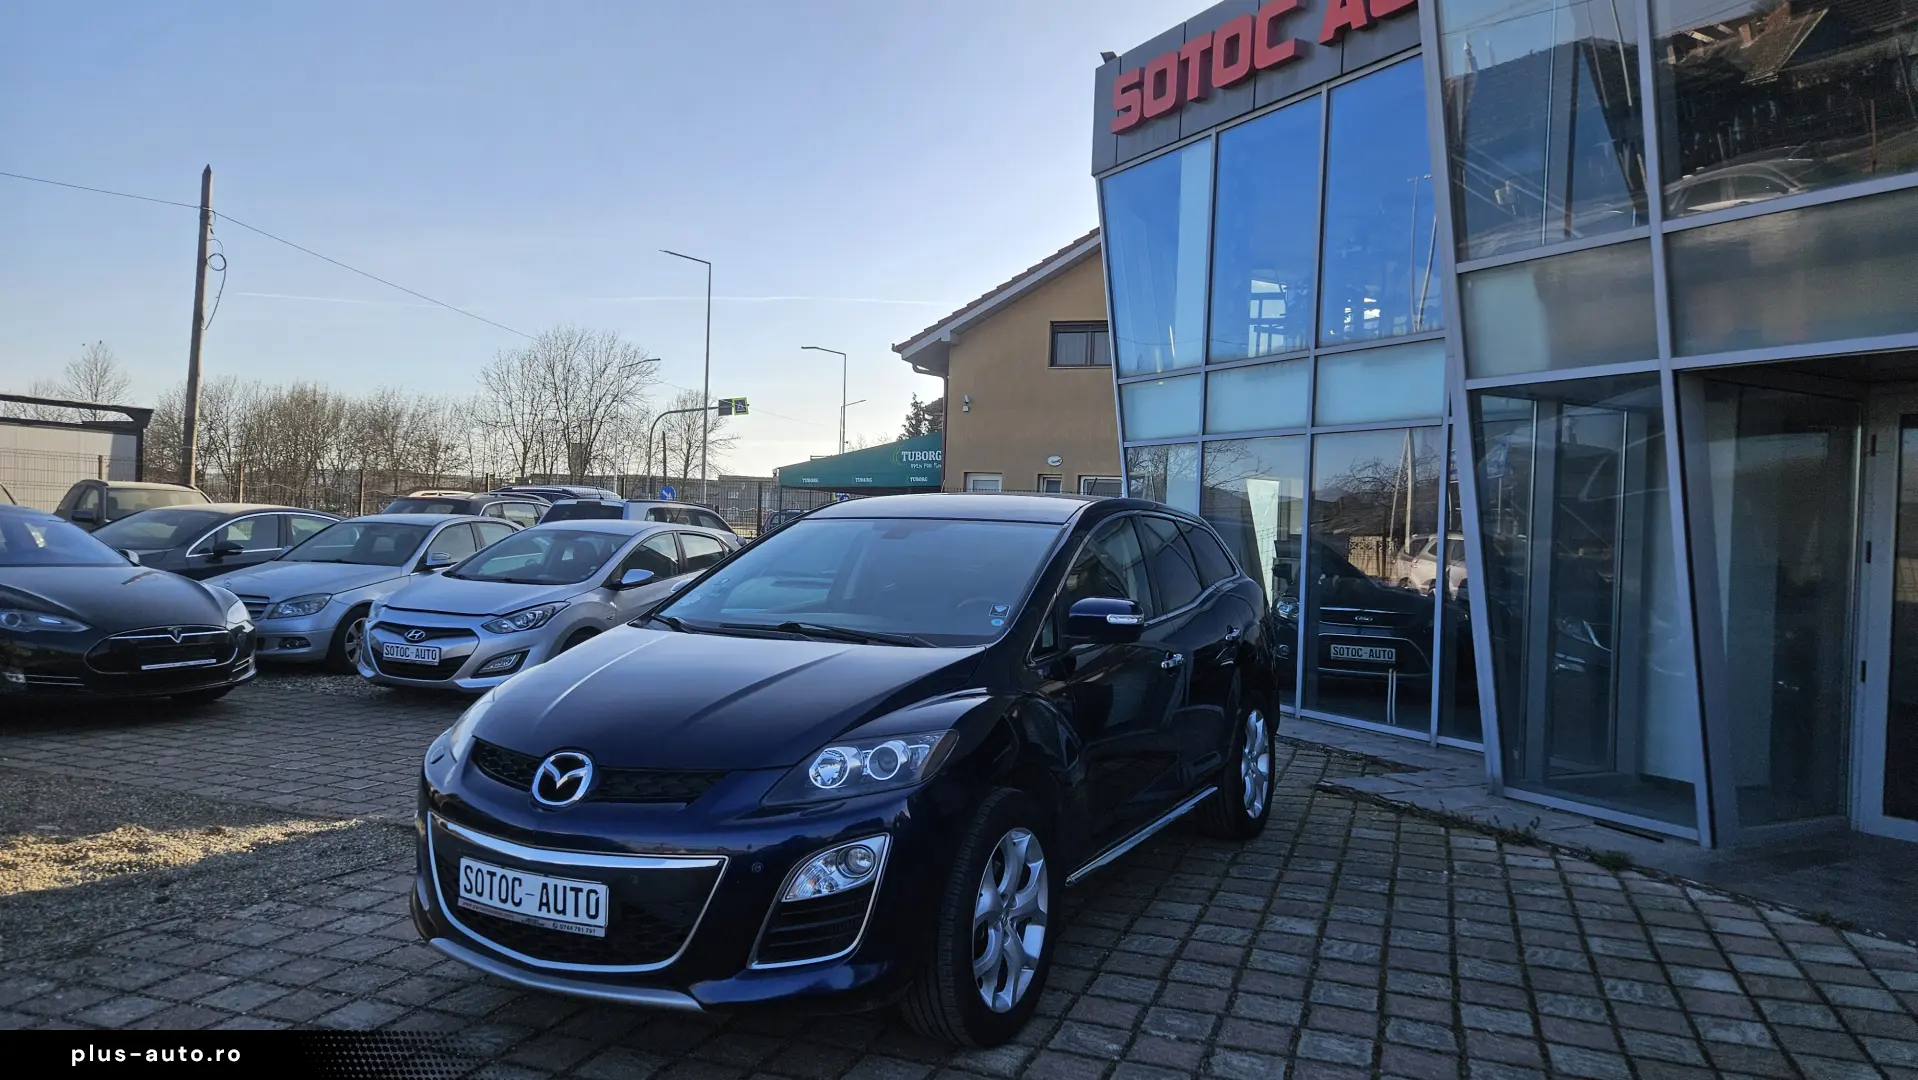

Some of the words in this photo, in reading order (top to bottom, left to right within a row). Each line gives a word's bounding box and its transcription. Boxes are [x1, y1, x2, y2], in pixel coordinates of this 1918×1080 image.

[1110, 0, 1300, 135] SOTOC
[1318, 0, 1418, 45] A
[901, 450, 942, 462] TUBORG
[385, 645, 436, 660] SOTOC-AUTO
[1333, 646, 1393, 659] SOTOC-AUTO
[463, 864, 600, 920] SOTOC-AUTO
